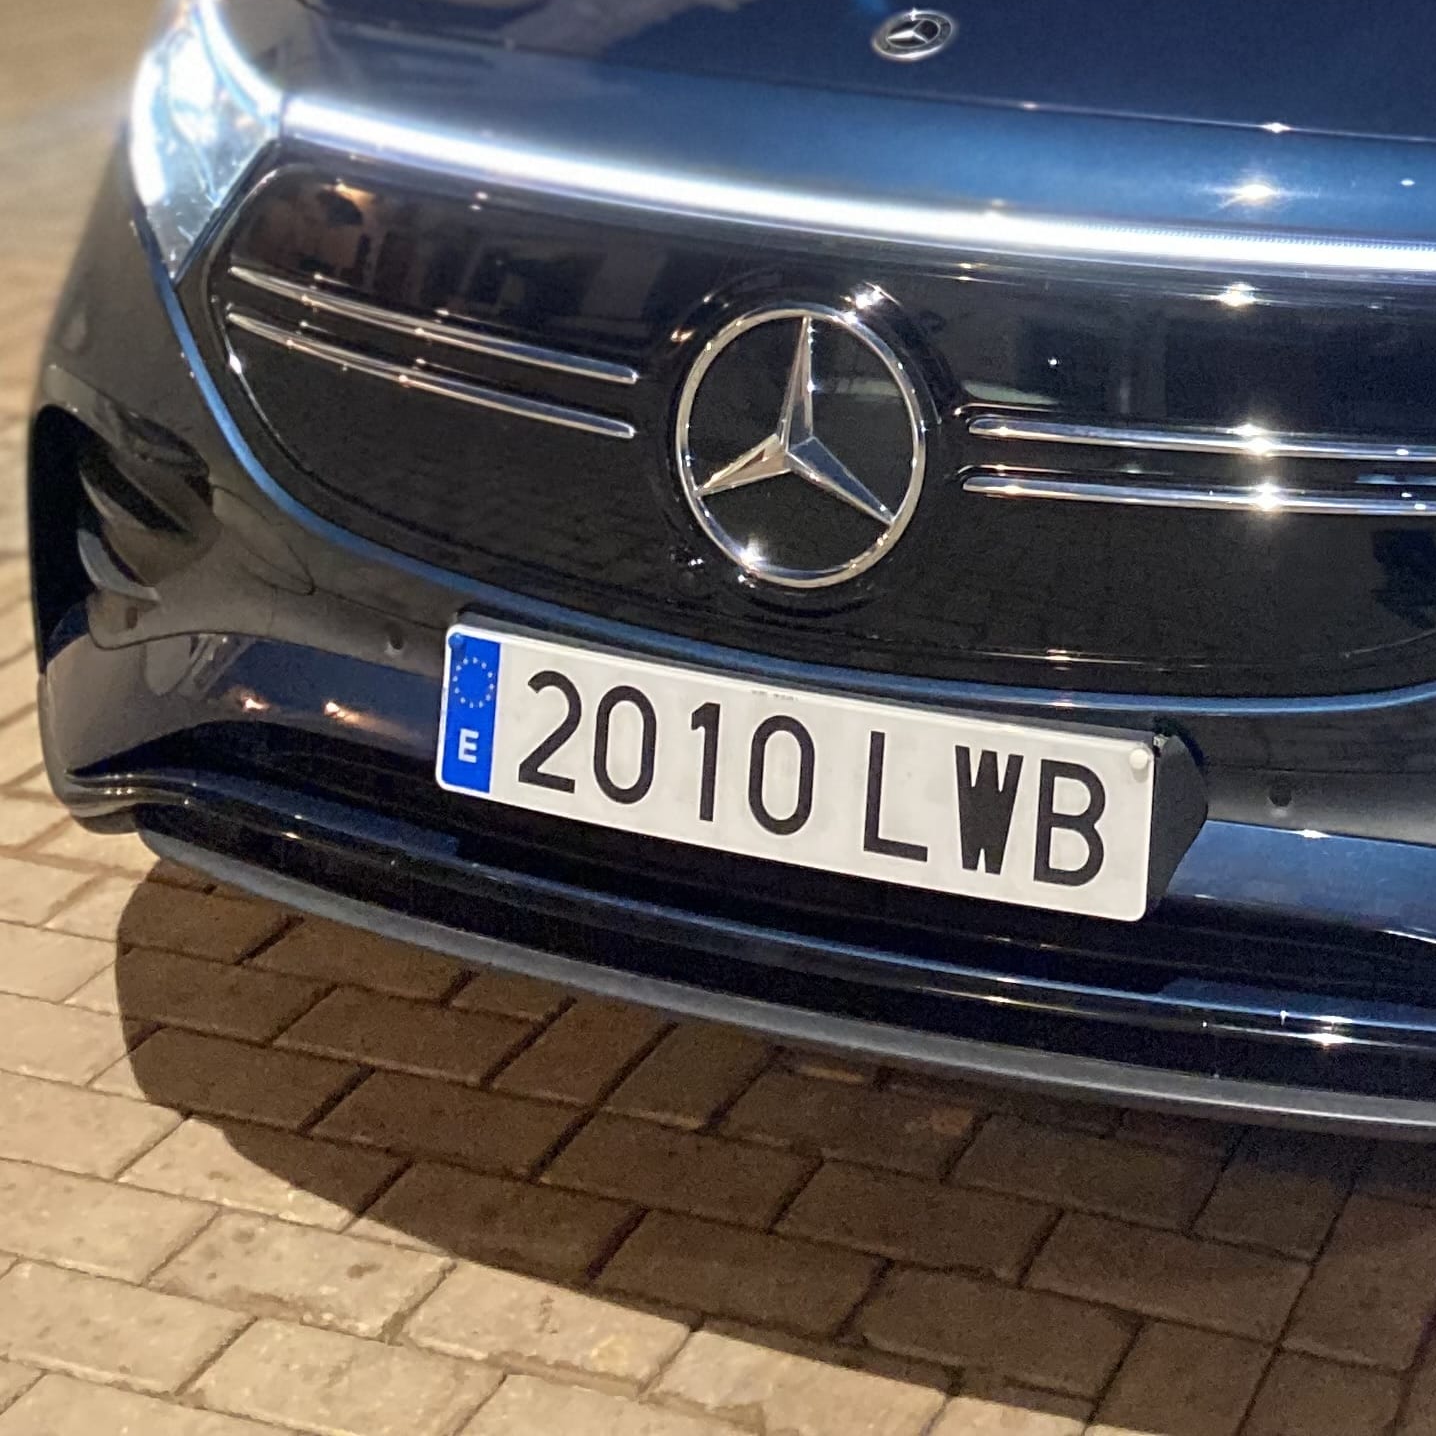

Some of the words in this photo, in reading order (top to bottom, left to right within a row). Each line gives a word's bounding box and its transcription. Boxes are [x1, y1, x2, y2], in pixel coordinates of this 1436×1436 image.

[458, 727, 479, 763] E
[518, 669, 815, 836] 2010
[863, 730, 1106, 887] LWB
